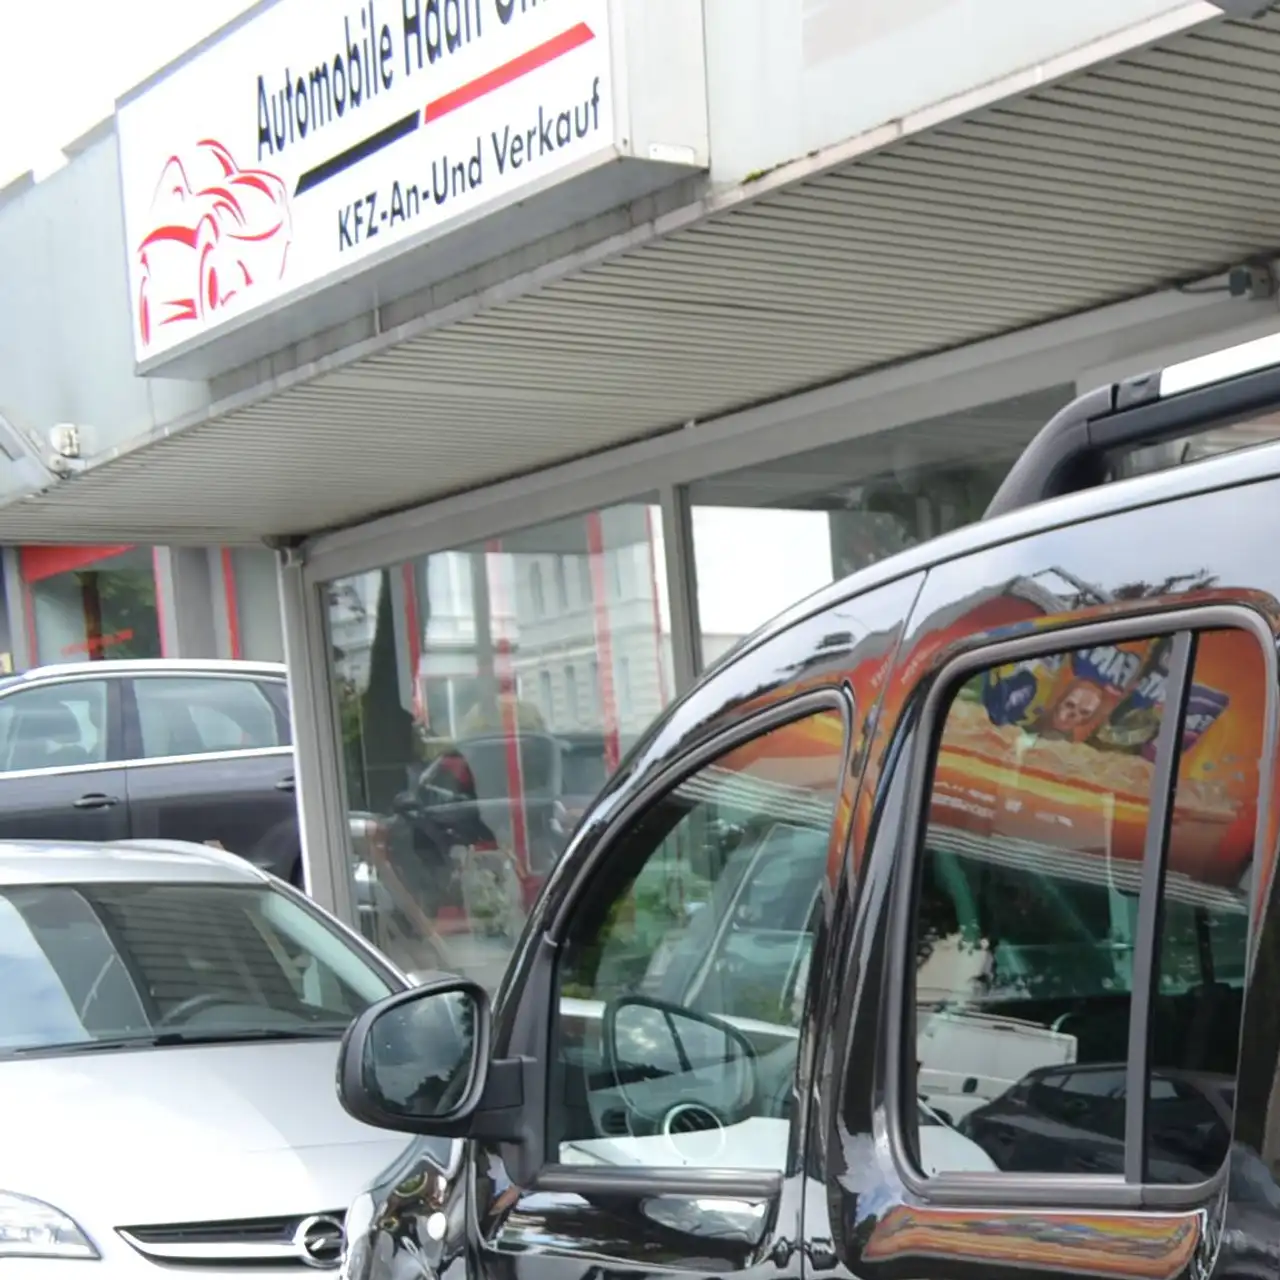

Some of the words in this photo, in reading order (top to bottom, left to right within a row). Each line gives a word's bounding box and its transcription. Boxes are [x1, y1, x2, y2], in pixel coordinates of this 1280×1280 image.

[257, 0, 393, 162] Automobile
[337, 136, 483, 252] KFZ-An-Und
[491, 76, 600, 175] Verkauf
